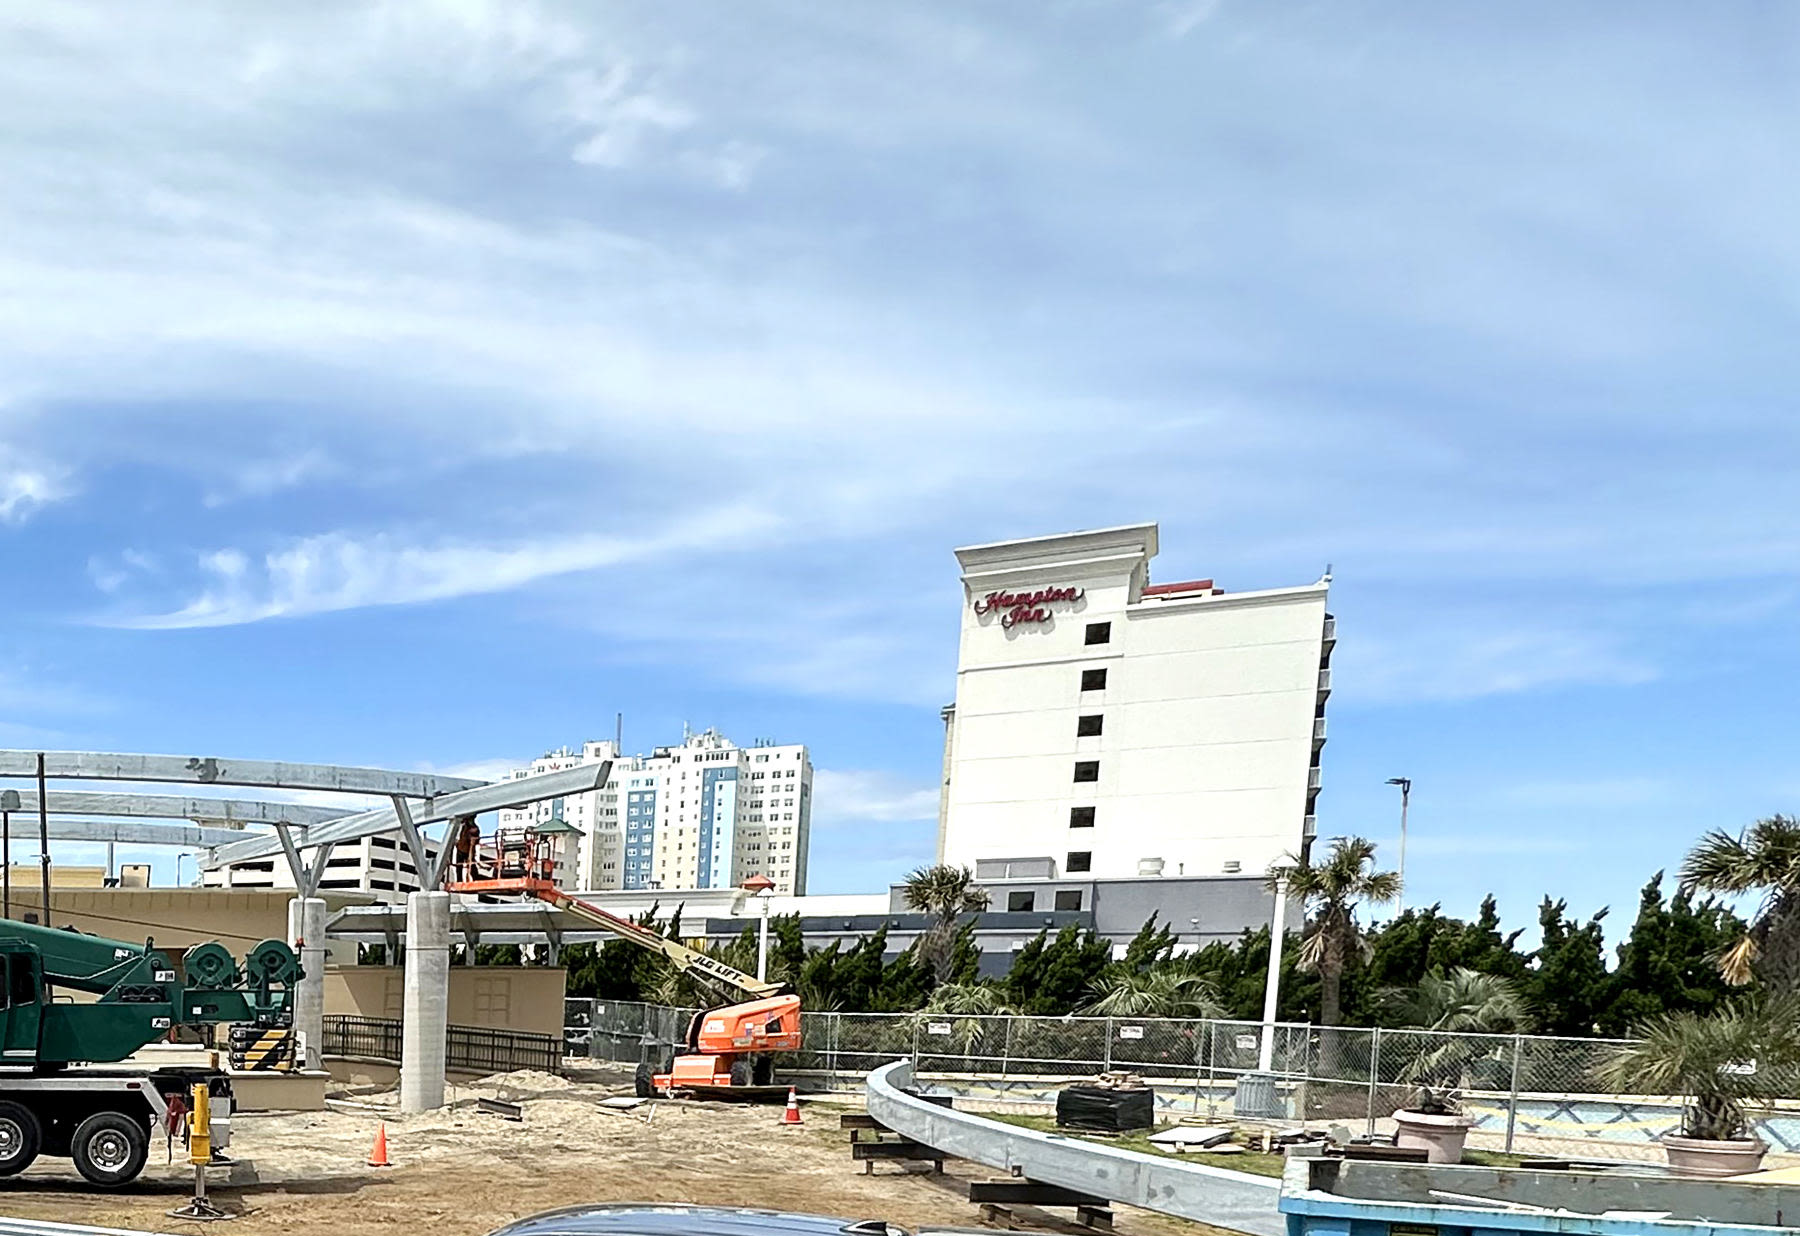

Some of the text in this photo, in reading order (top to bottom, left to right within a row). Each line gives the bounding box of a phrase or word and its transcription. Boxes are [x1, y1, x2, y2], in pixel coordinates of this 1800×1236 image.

[974, 586, 1085, 615] Hampton
[1001, 606, 1052, 629] Inn
[693, 956, 715, 970] JLG
